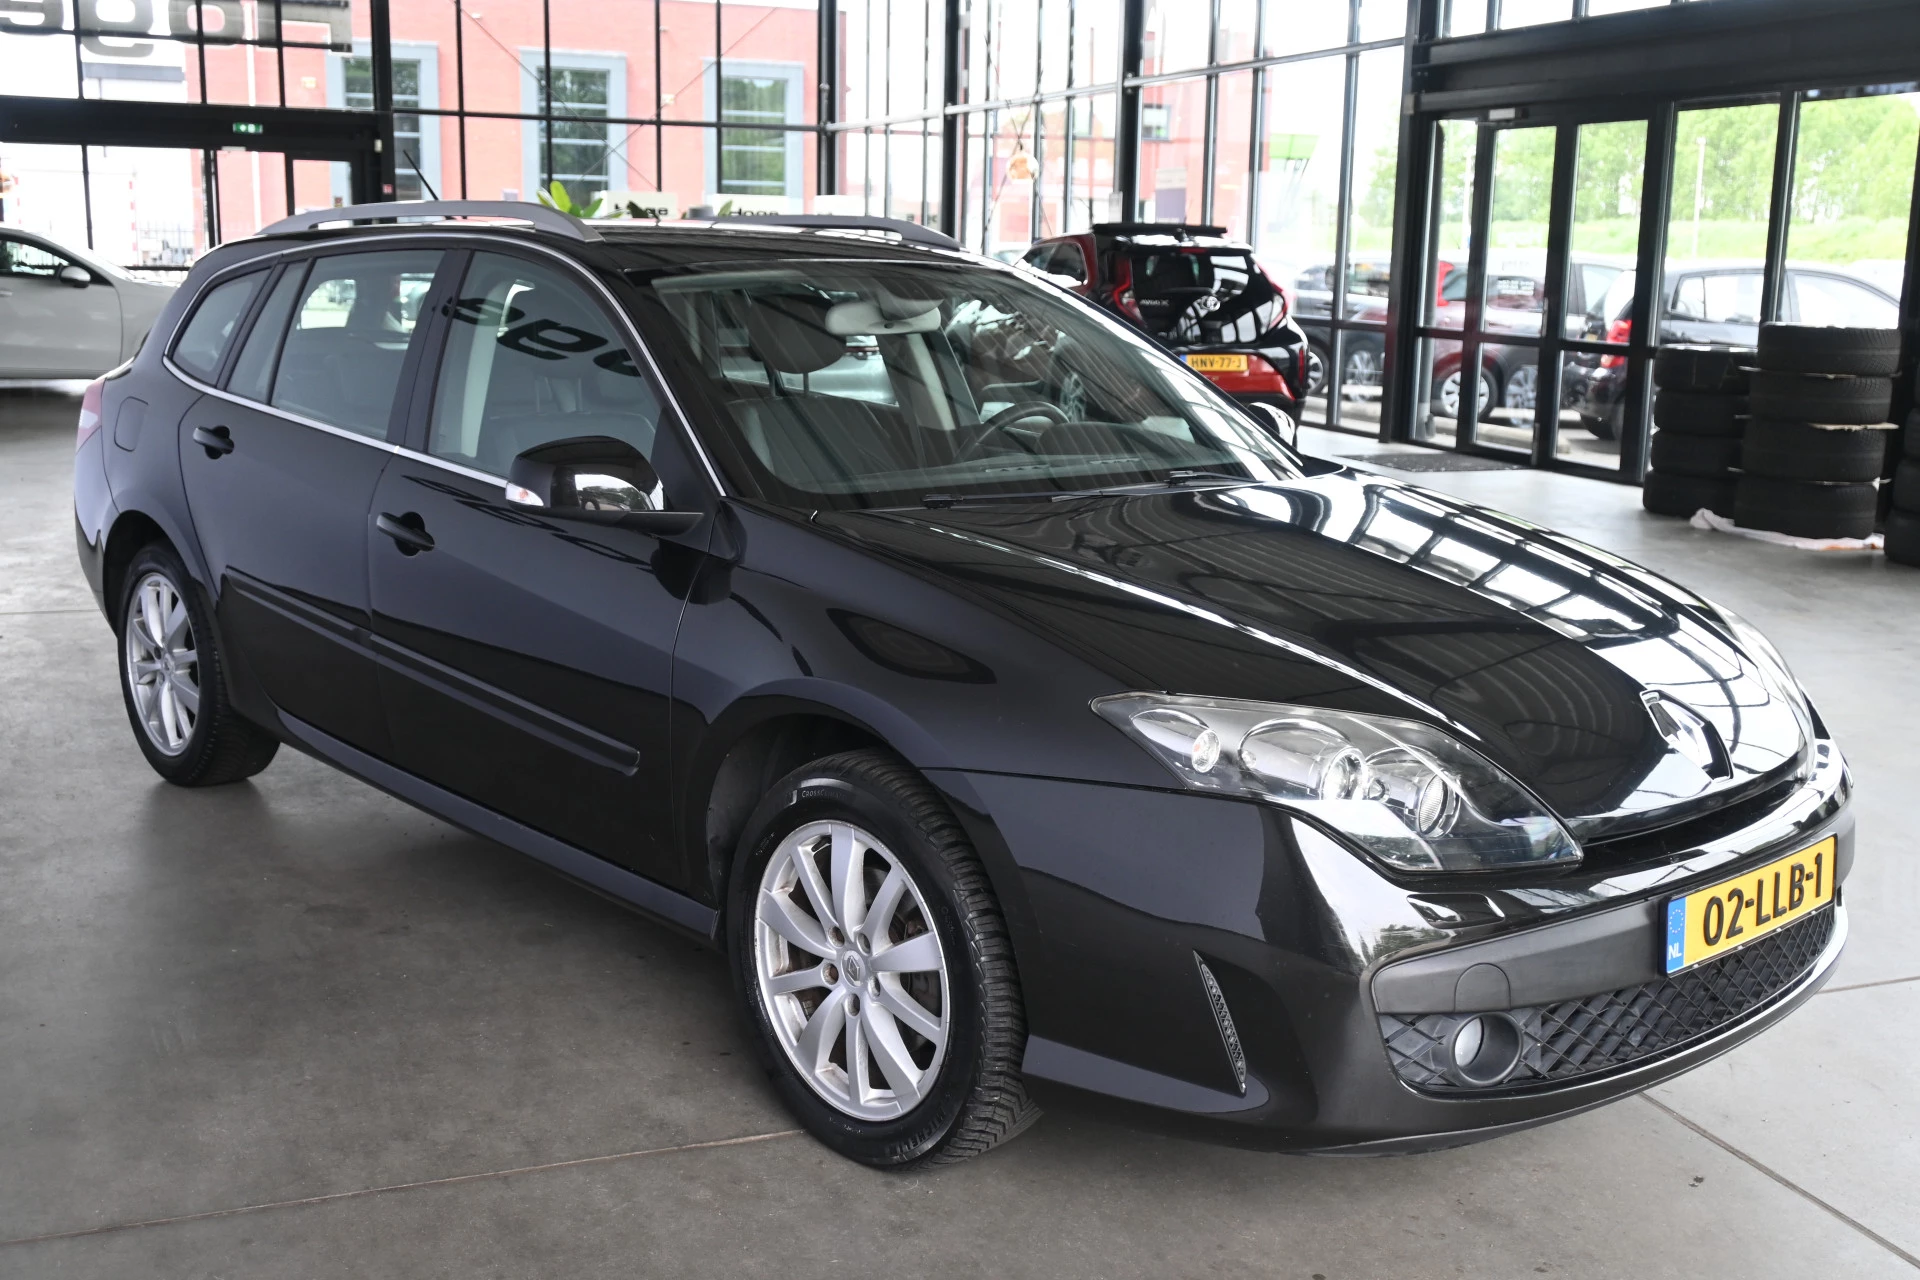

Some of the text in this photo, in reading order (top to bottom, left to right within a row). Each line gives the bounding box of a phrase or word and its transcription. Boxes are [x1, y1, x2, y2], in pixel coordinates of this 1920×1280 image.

[1191, 358, 1242, 368] HNV-77-J
[1703, 852, 1823, 947] 02-LLB-1
[1668, 942, 1682, 960] NL
